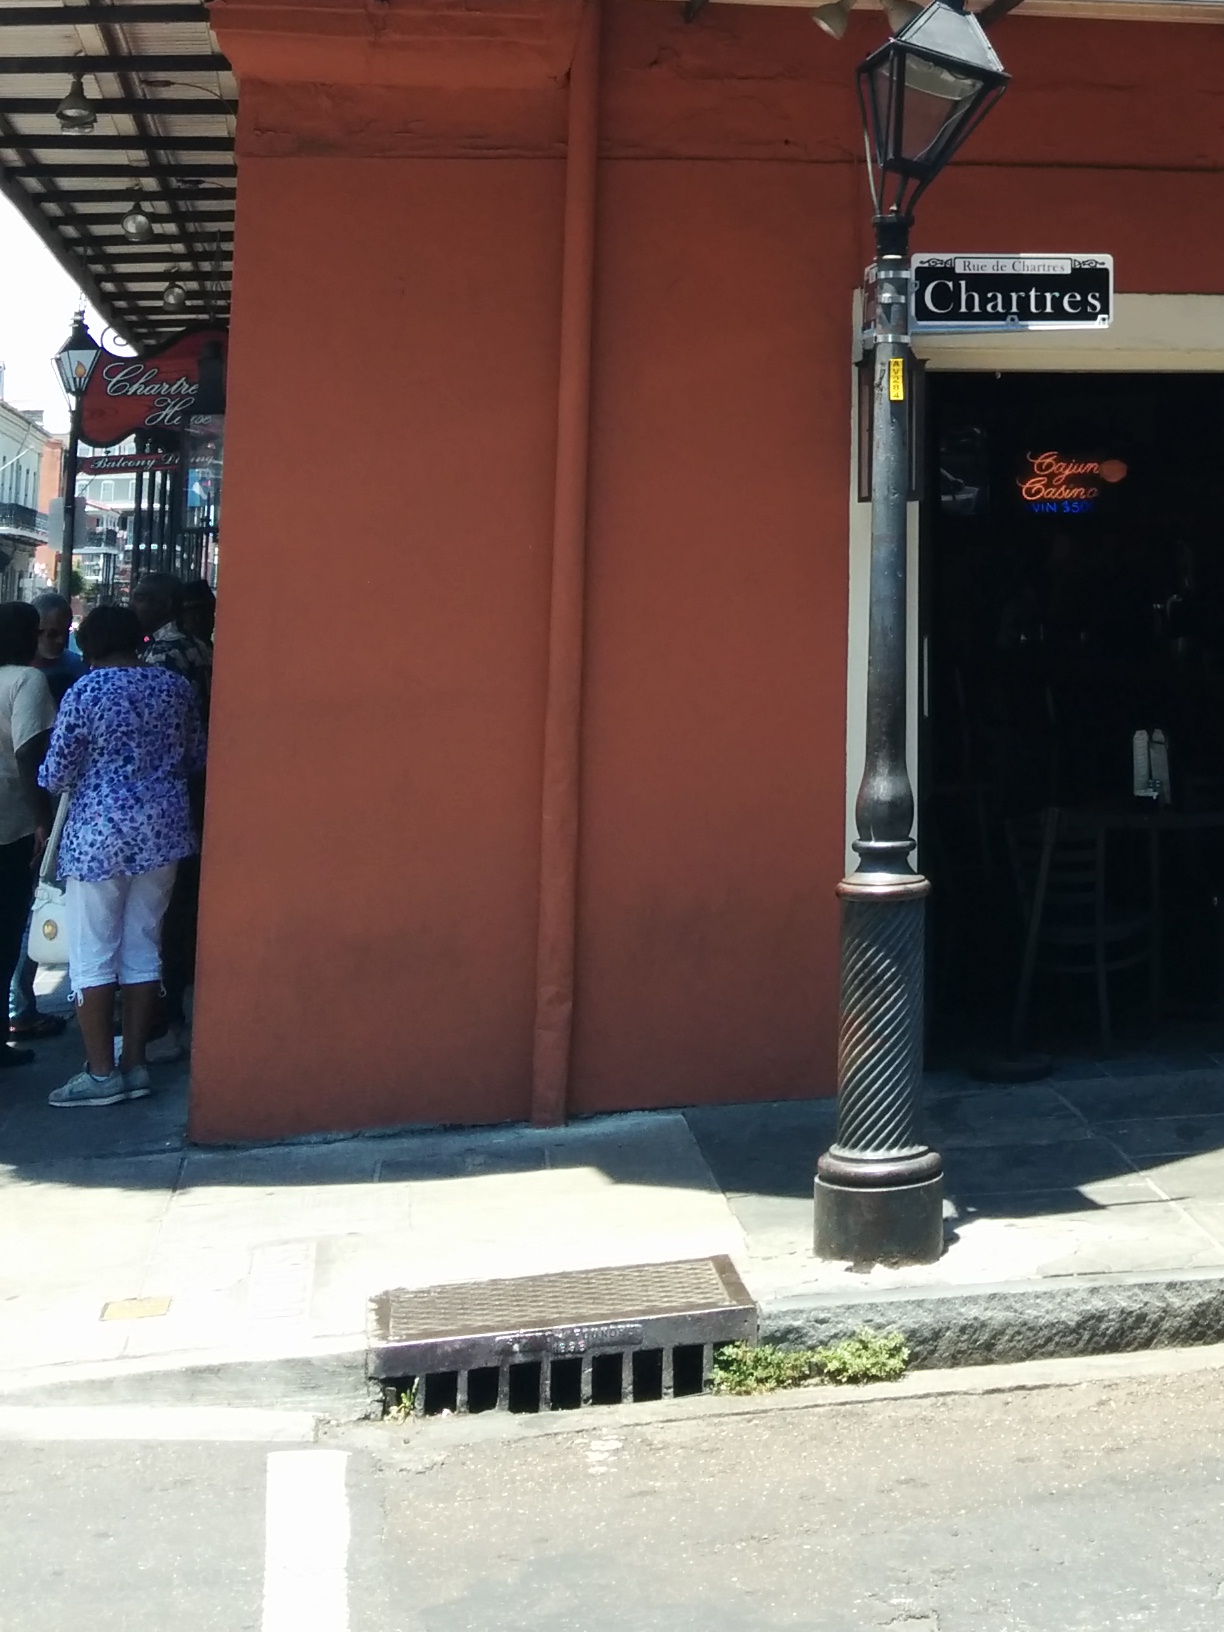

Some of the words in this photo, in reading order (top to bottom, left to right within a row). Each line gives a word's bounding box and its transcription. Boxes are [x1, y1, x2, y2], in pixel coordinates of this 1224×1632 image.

[963, 260, 987, 272] Rue
[992, 260, 1007, 272] de
[1012, 259, 1066, 272] Chartres
[924, 279, 1102, 314] Chartres
[103, 362, 199, 396] Chartre
[91, 457, 155, 469] Balcony
[161, 453, 213, 465] Diing
[1026, 451, 1100, 485] Cajun
[1016, 476, 1098, 500] Casino
